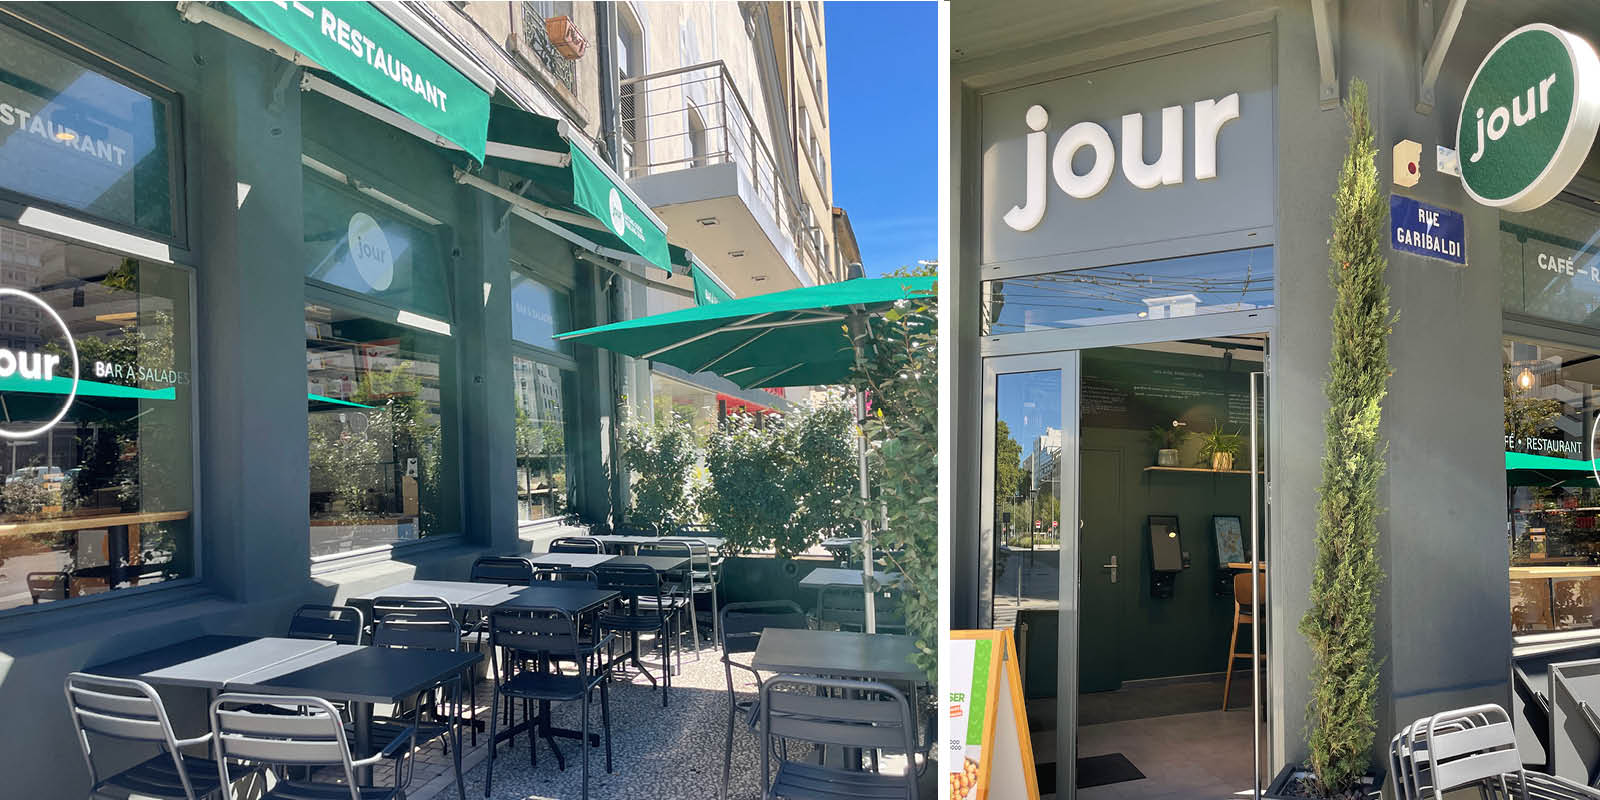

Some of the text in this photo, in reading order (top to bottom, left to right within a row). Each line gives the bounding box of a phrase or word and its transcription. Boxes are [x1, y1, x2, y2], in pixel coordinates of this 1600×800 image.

[321, 7, 447, 112] RESTAURANT
[1469, 72, 1556, 163] jour
[0, 103, 126, 167] STAURANT
[1003, 92, 1240, 233] jour
[1418, 208, 1440, 227] RUE
[357, 235, 386, 264] jour
[1397, 227, 1461, 257] GARIBALDI
[1537, 253, 1574, 276] CAFÉ
[95, 361, 123, 379] BAR
[139, 367, 190, 385] SALADES
[1526, 437, 1582, 454] RESTAURANT
